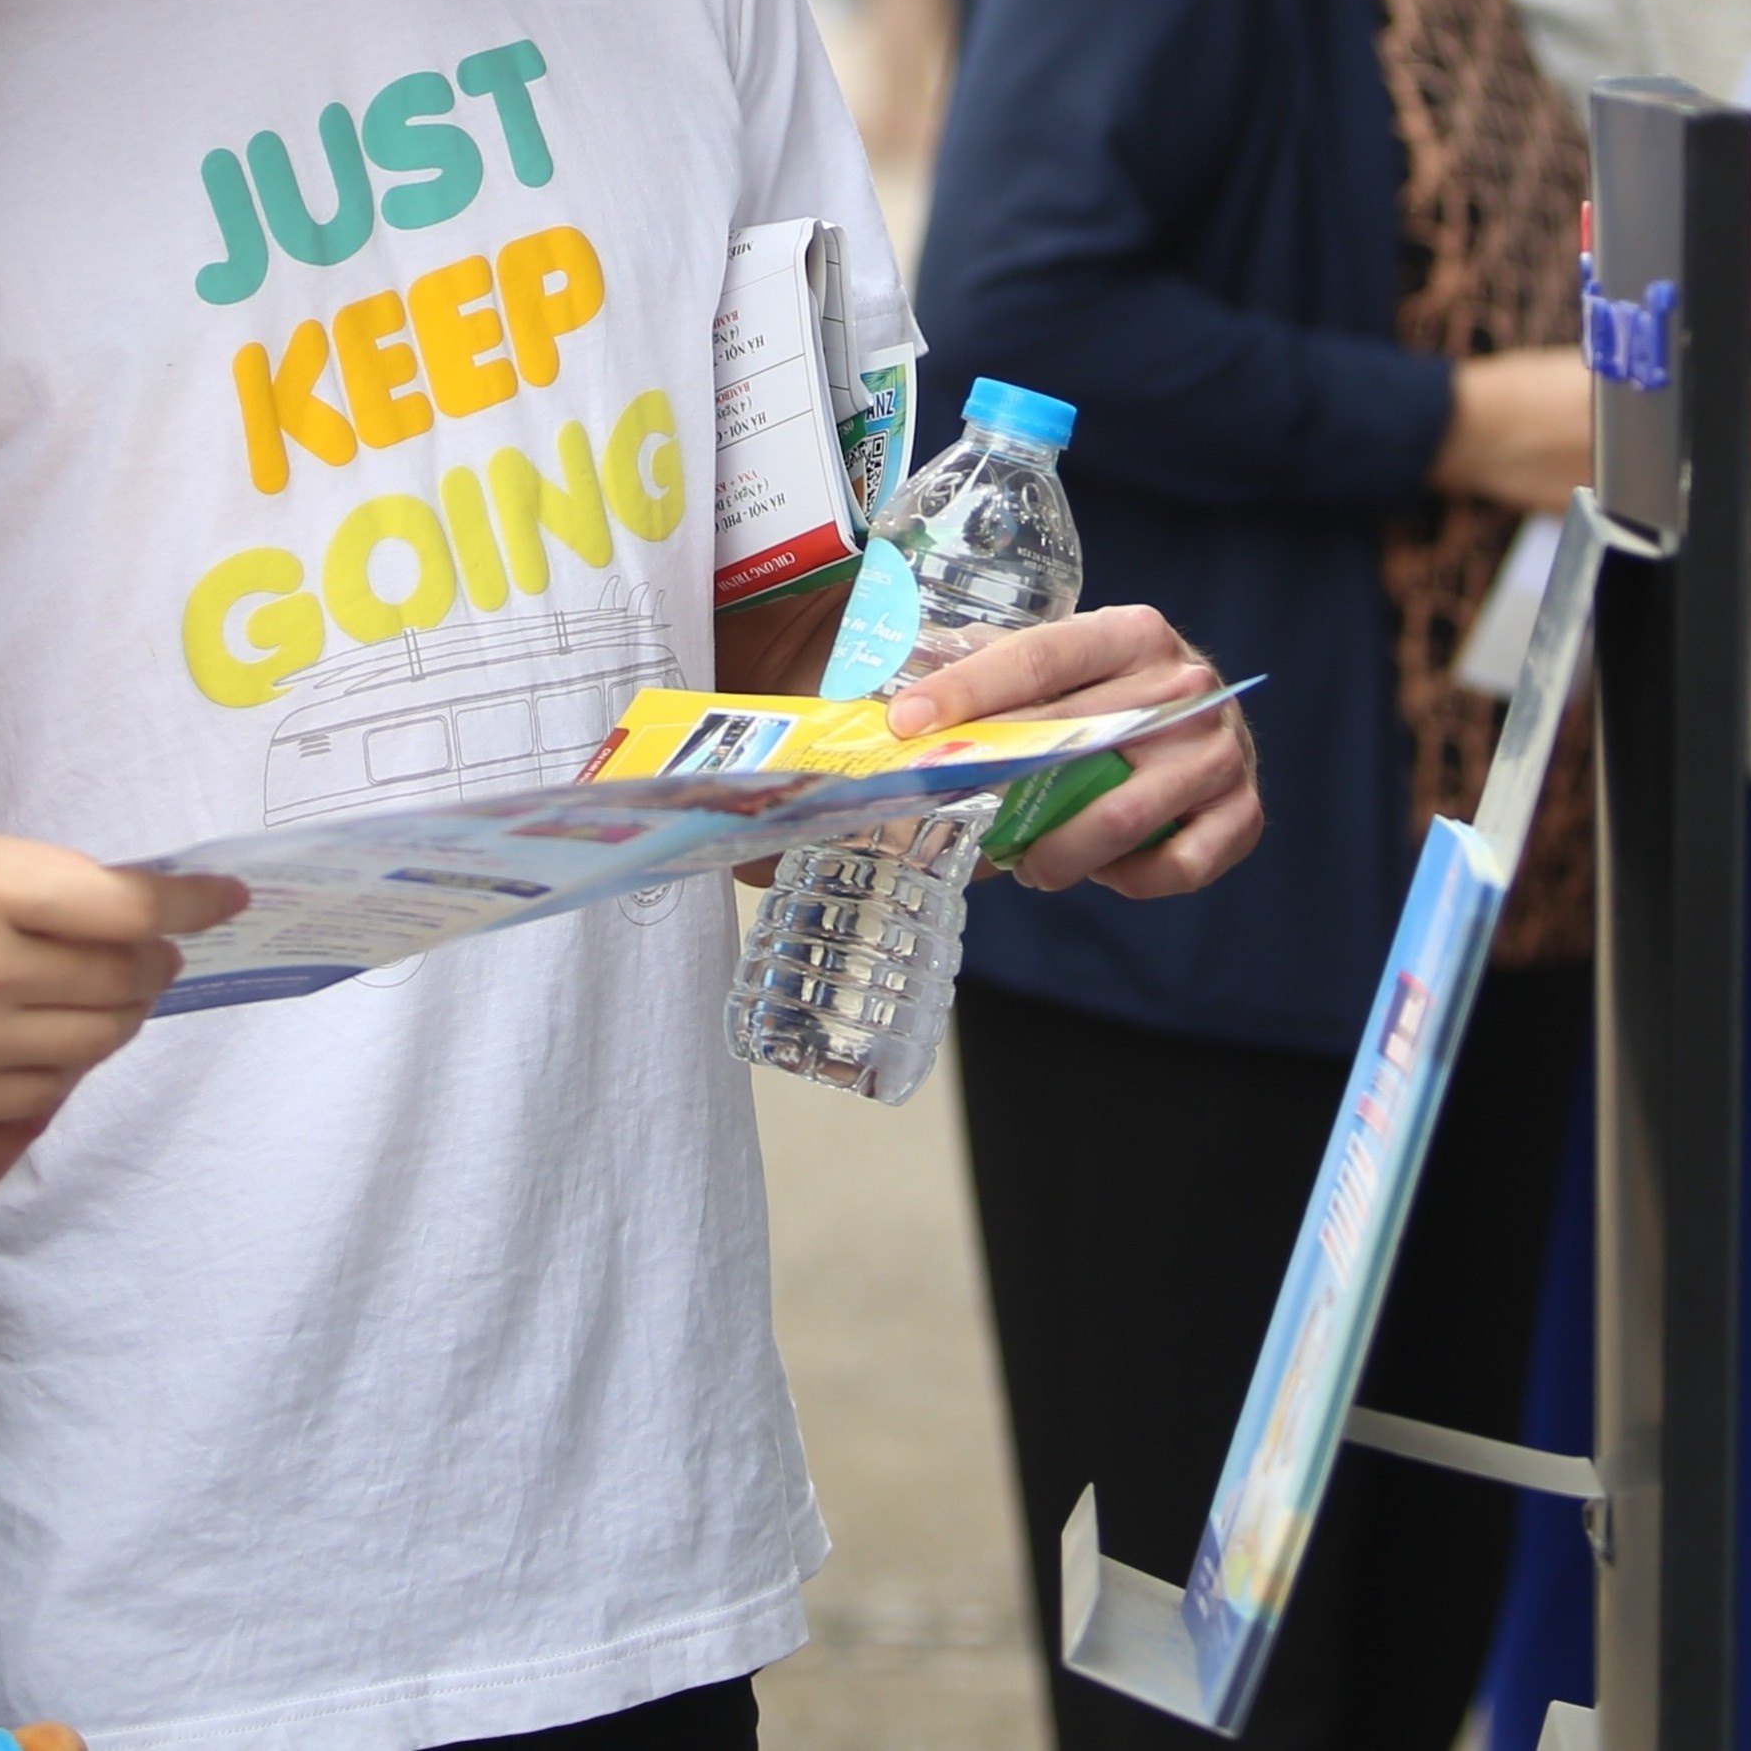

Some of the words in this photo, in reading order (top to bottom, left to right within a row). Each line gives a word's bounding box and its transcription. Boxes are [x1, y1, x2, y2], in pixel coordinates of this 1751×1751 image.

[194, 37, 555, 307] JUST
[231, 223, 607, 496] KEEP
[180, 387, 687, 710] GOING
